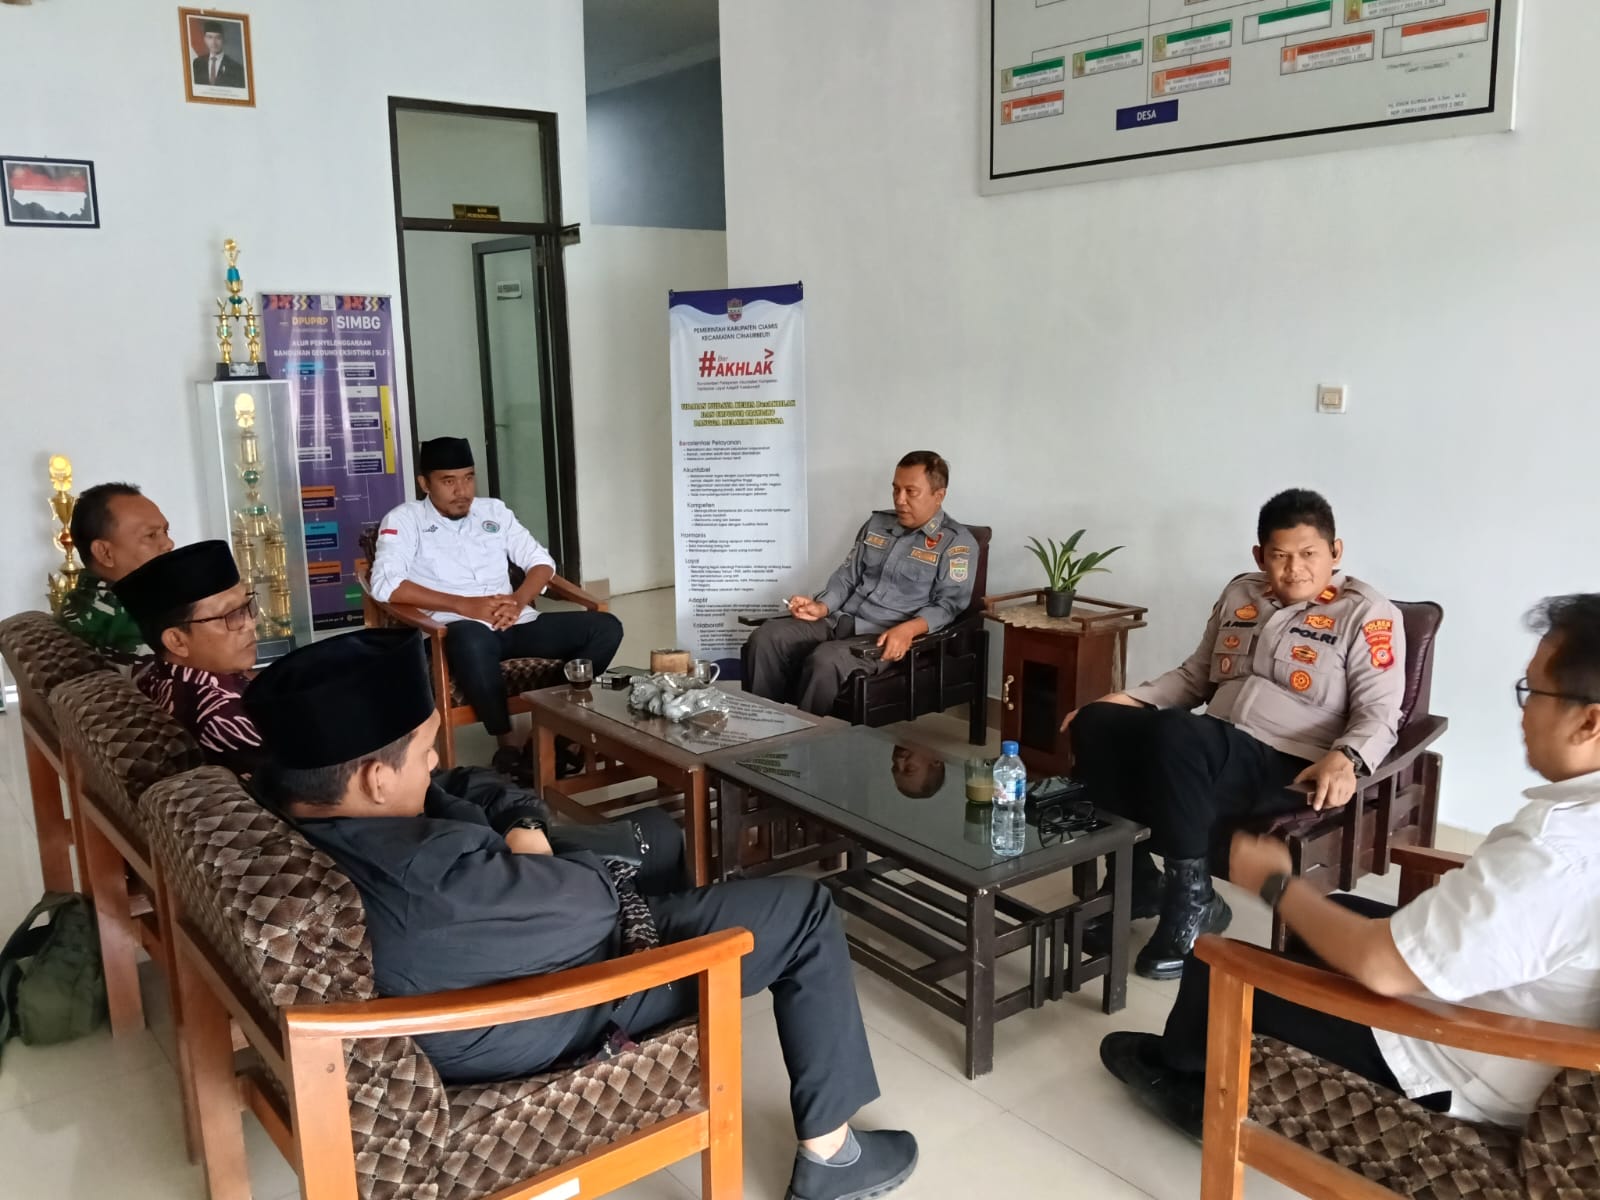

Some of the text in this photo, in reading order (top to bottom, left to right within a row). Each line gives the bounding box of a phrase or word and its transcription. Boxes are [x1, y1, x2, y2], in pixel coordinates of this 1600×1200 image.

[1136, 109, 1157, 122] DESA
[336, 315, 381, 330] SIMBG
[693, 326, 726, 334] PEMERINTAH
[727, 324, 757, 333] KABUPATEN
[1289, 626, 1338, 646] POLRI
